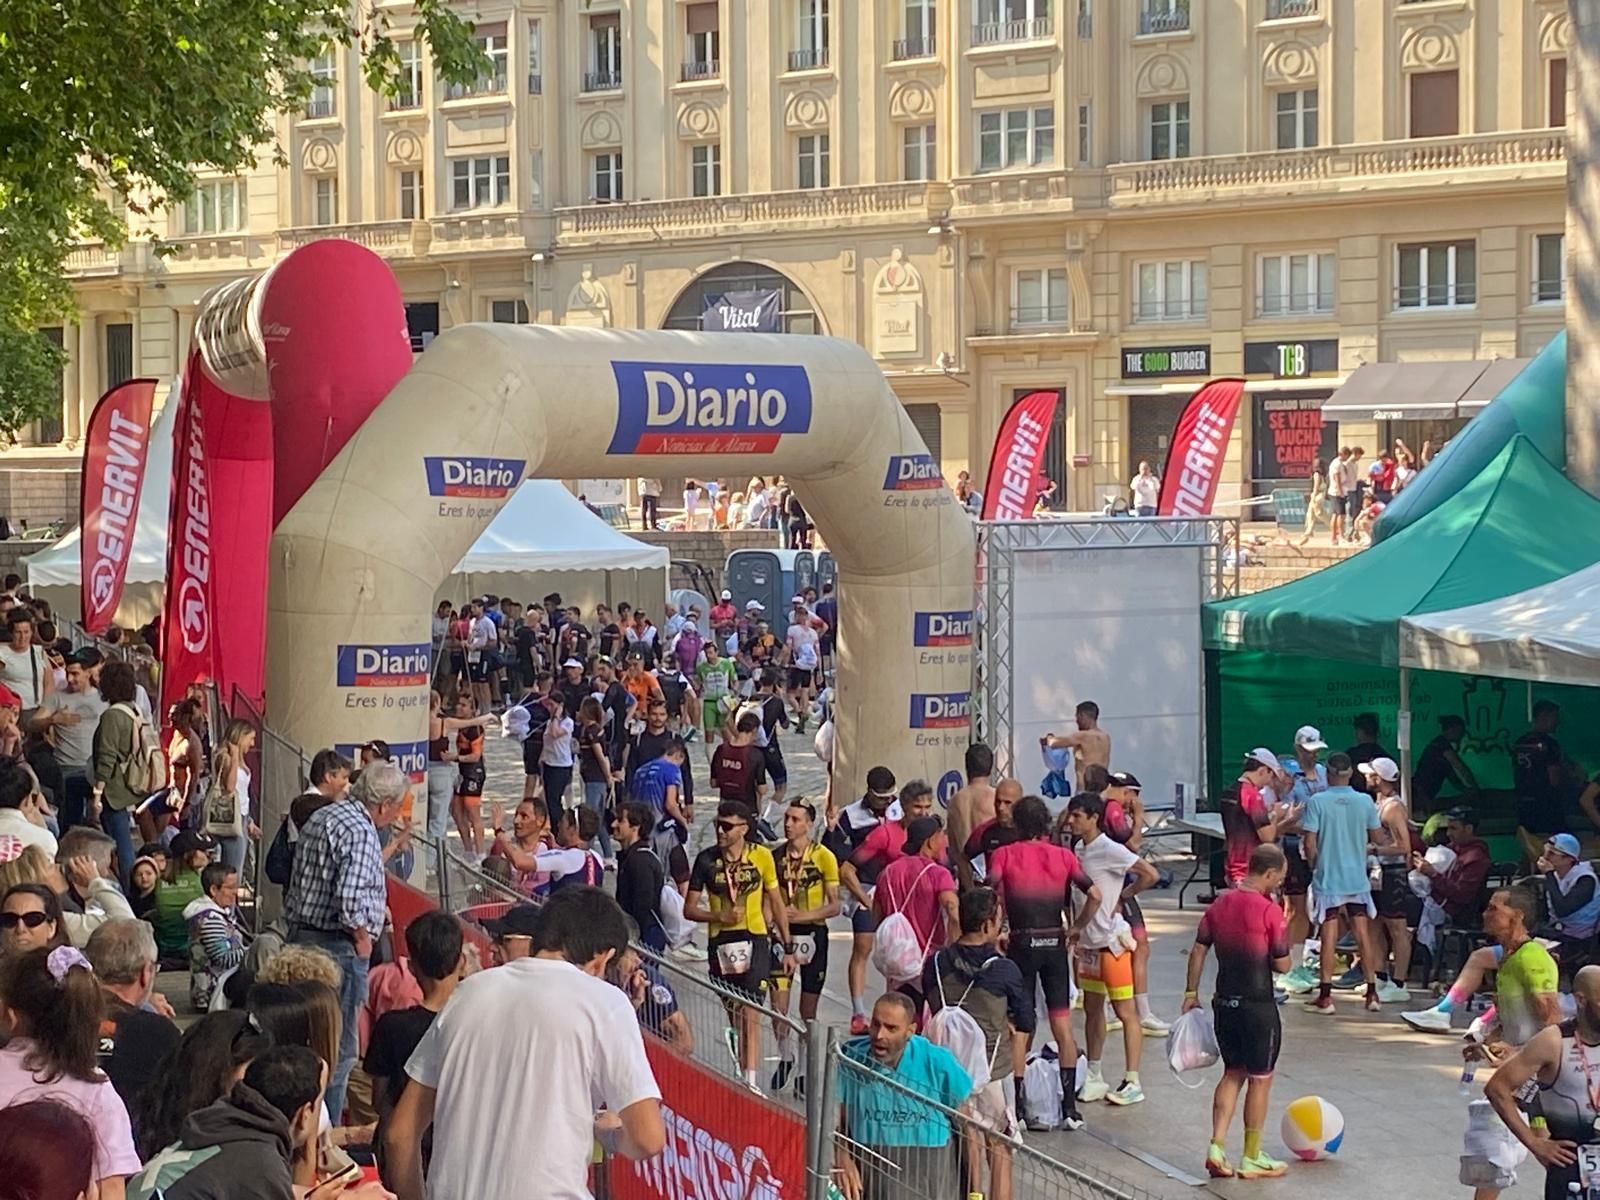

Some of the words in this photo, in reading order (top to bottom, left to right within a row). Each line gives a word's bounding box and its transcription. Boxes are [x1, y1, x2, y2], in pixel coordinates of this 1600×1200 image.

[719, 306, 761, 329] Vital
[1126, 353, 1143, 373] THE
[1144, 352, 1169, 372] GOOD
[1170, 351, 1206, 371] BURGER
[1277, 344, 1306, 376] TGB
[644, 371, 787, 427] Diario
[1269, 411, 1286, 429] SE
[1275, 428, 1322, 447] MUCHA
[442, 460, 514, 487] Diario
[97, 409, 144, 562] ENERVIT
[439, 502, 463, 517] Eres
[466, 504, 475, 517] lo
[356, 648, 428, 674] Diario
[920, 652, 944, 664] Eres
[345, 693, 377, 708] Eres
[382, 693, 394, 708] lo
[398, 696, 418, 711] que
[915, 734, 940, 746] Eres
